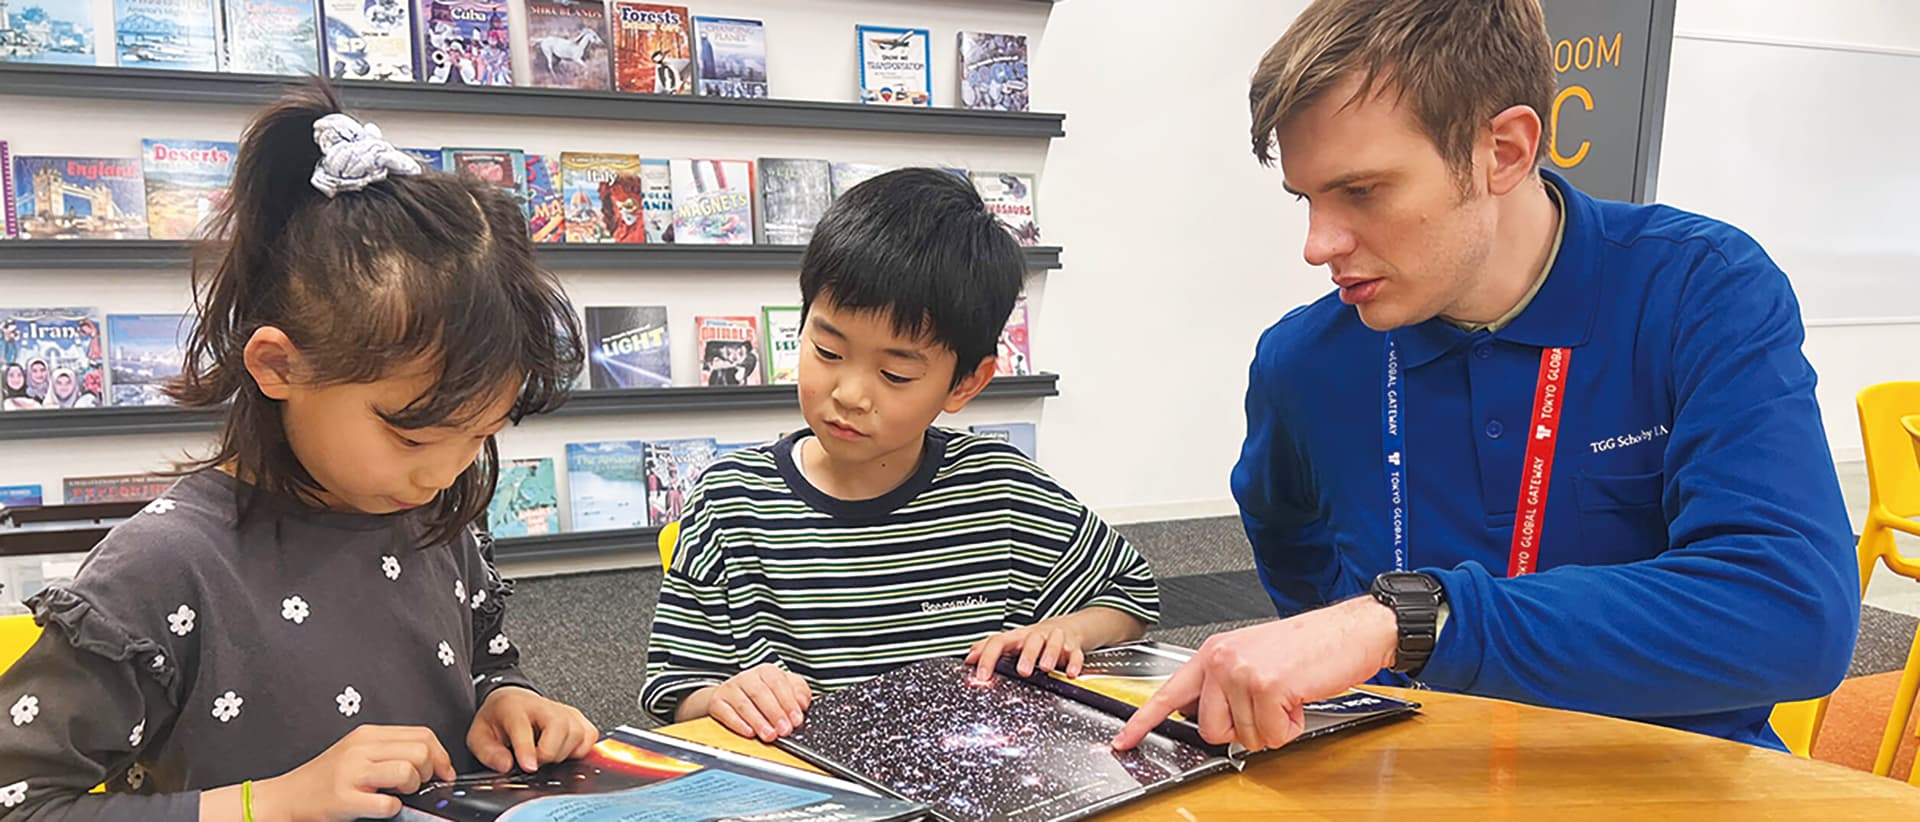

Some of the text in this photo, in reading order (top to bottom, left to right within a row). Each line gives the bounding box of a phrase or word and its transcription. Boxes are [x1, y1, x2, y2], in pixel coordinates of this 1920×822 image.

[451, 7, 488, 22] Cuba
[621, 7, 680, 25] Forests
[1550, 85, 1594, 169] C
[153, 144, 230, 164] Deserts
[66, 160, 140, 180] England
[586, 169, 617, 186] Italy
[678, 193, 749, 218] MAGNETS
[30, 323, 77, 339] Iran
[602, 326, 665, 358] LIGHT
[1386, 390, 1398, 436] GATEWAY
[1541, 384, 1557, 419] TOKYO
[1589, 437, 1616, 453] TGG
[1390, 471, 1401, 505] TOKYO
[1527, 456, 1545, 505] GATEWAY
[1393, 507, 1403, 546] GLOBAL
[1520, 508, 1537, 548] GLOBAL
